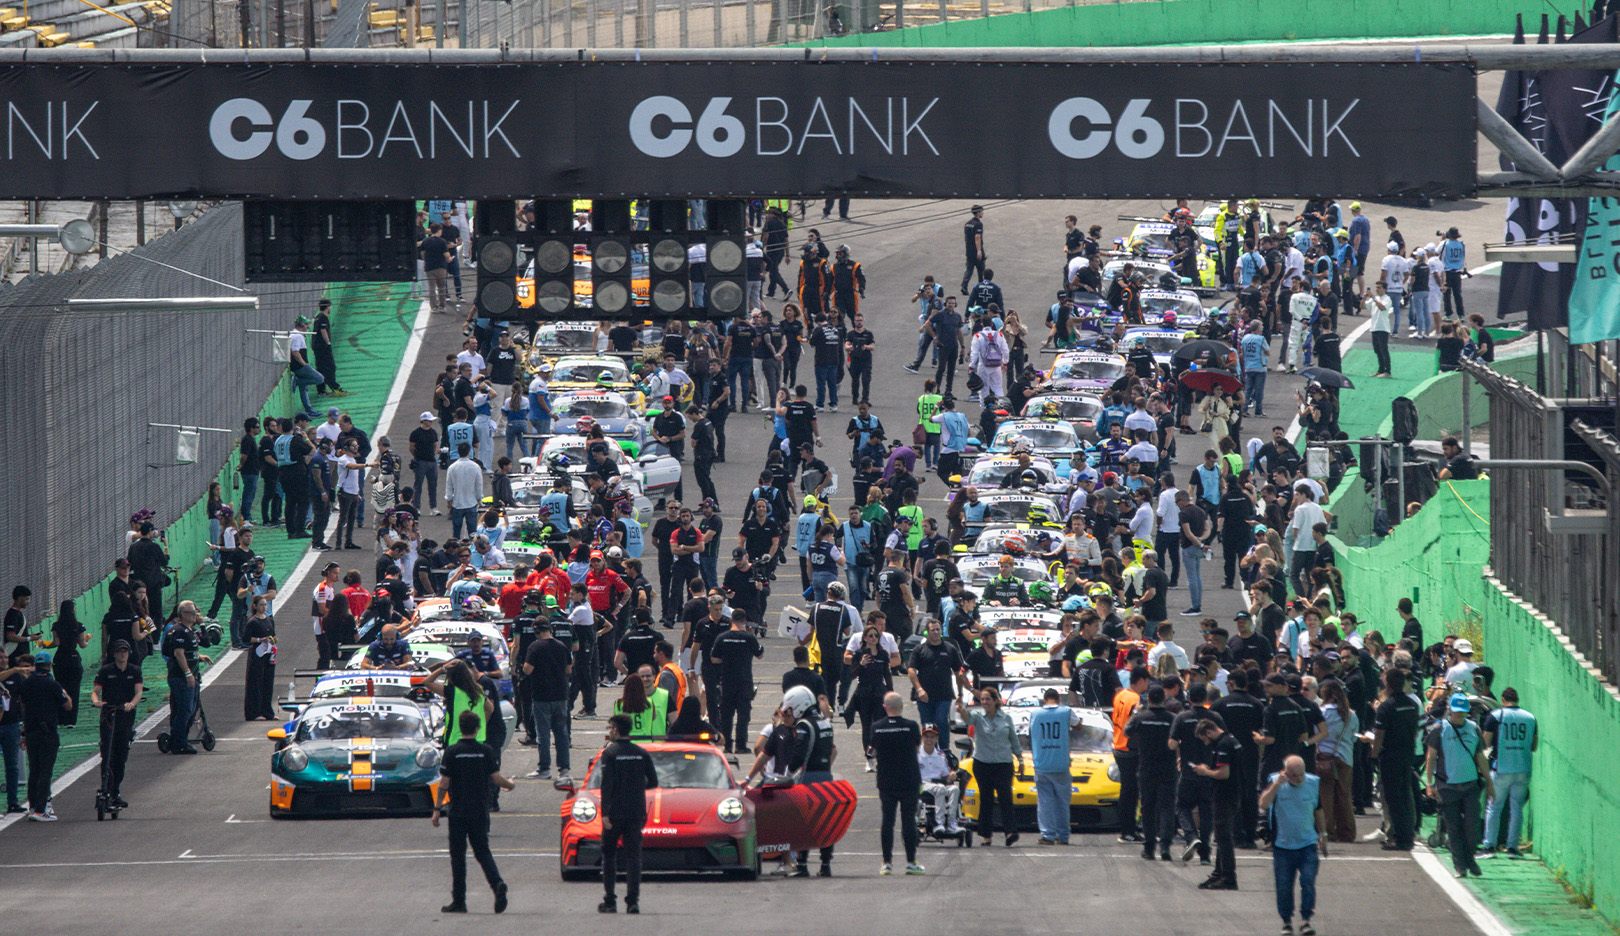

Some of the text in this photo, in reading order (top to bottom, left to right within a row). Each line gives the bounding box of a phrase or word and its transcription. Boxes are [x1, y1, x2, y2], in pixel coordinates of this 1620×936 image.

[453, 428, 468, 441] 155
[331, 705, 375, 713] Mobil
[1040, 721, 1060, 739] 110
[1504, 722, 1527, 740] 109
[778, 843, 791, 852] CAR
